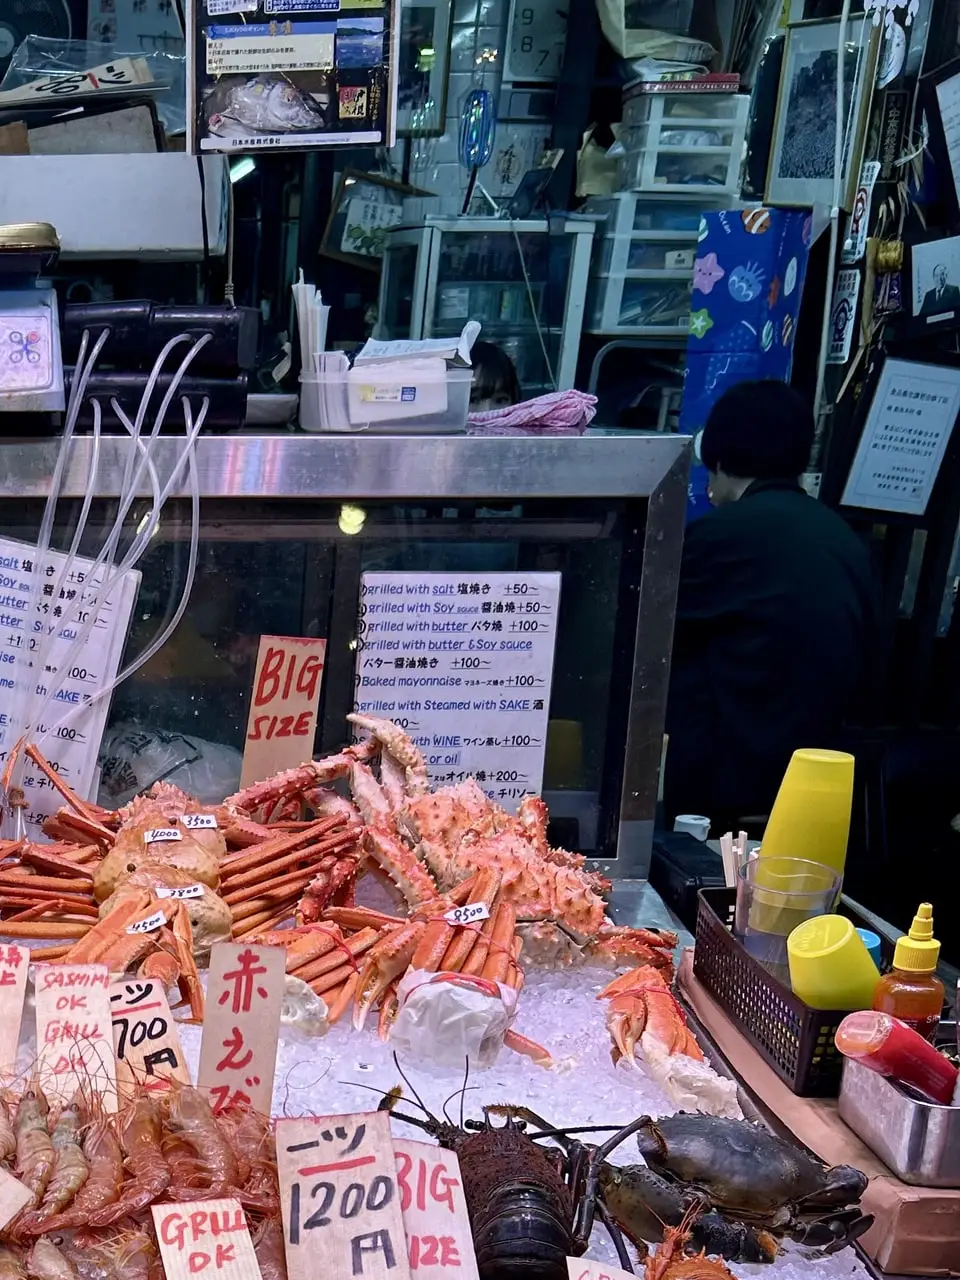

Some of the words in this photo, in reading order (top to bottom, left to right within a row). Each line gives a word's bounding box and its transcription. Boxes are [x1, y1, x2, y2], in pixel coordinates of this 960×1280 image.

[521, 8, 534, 25] 9
[520, 36, 533, 53] 8
[534, 50, 549, 73] 7
[367, 584, 403, 595] grilled
[406, 584, 429, 594] with
[432, 584, 454, 594] salt
[457, 582, 491, 595] 塩焼き
[368, 603, 404, 614] grilled
[406, 603, 431, 613] with
[433, 602, 455, 614] Soy
[368, 621, 403, 632] grilled
[406, 621, 430, 632] with
[431, 621, 468, 632] butter
[471, 620, 502, 632] バタ焼
[364, 640, 399, 651] grilled
[402, 640, 426, 650] with
[428, 639, 464, 650] butter
[500, 641, 533, 650] sauce
[363, 657, 439, 669] バター醤油焼き
[254, 646, 324, 707] BIG
[362, 676, 396, 687] Baked
[398, 676, 462, 689] mayonnaise
[360, 701, 395, 711] grilled
[398, 701, 421, 710] with
[424, 700, 470, 710] Steamed
[473, 700, 496, 709] with
[499, 700, 529, 710] SAKE
[533, 700, 544, 710] 酒
[248, 712, 313, 741] SIZE
[433, 735, 461, 746] WINE
[430, 756, 441, 764] or
[445, 755, 457, 764] oil
[184, 815, 213, 827] 3500
[150, 829, 179, 841] 4000
[132, 917, 161, 932] 4500
[114, 1016, 168, 1059] 700
[290, 1175, 394, 1245] 1200
[161, 1209, 247, 1247] GRILL
[188, 1244, 236, 1273] OK
[351, 1228, 397, 1276] 円
[409, 1235, 461, 1270] IZE
